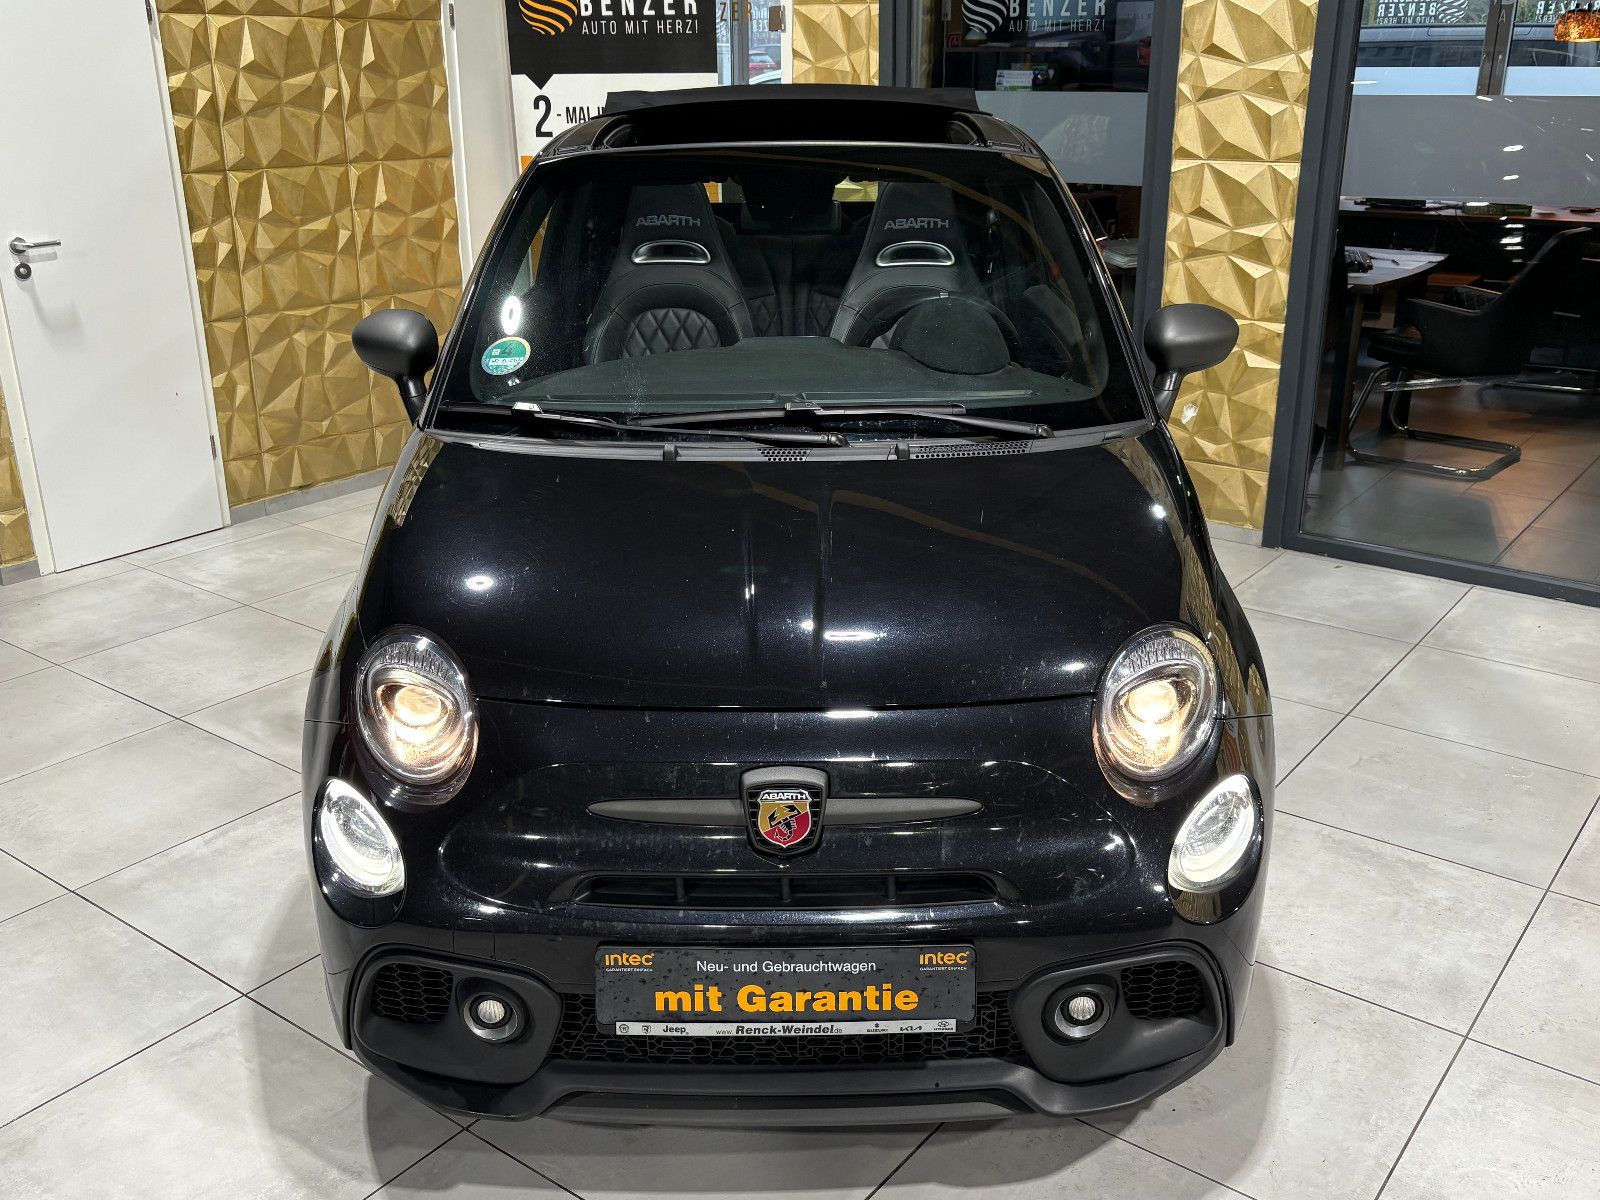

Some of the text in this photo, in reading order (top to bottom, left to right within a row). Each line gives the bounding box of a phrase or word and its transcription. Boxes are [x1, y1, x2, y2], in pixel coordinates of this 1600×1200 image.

[580, 0, 698, 16] BENZER
[1009, 0, 1106, 17] BENZER
[581, 19, 698, 35] AUTO MIT HERZ!
[1008, 18, 1105, 32] AUTO MIT HERZ!
[636, 214, 701, 227] ABARTH
[884, 217, 949, 230] ABARTH
[762, 792, 806, 800] ABARTH
[696, 960, 877, 974] Neu- und Gebrauchtwagen
[655, 983, 919, 1012] mit Garantie
[662, 1025, 687, 1035] Jeep
